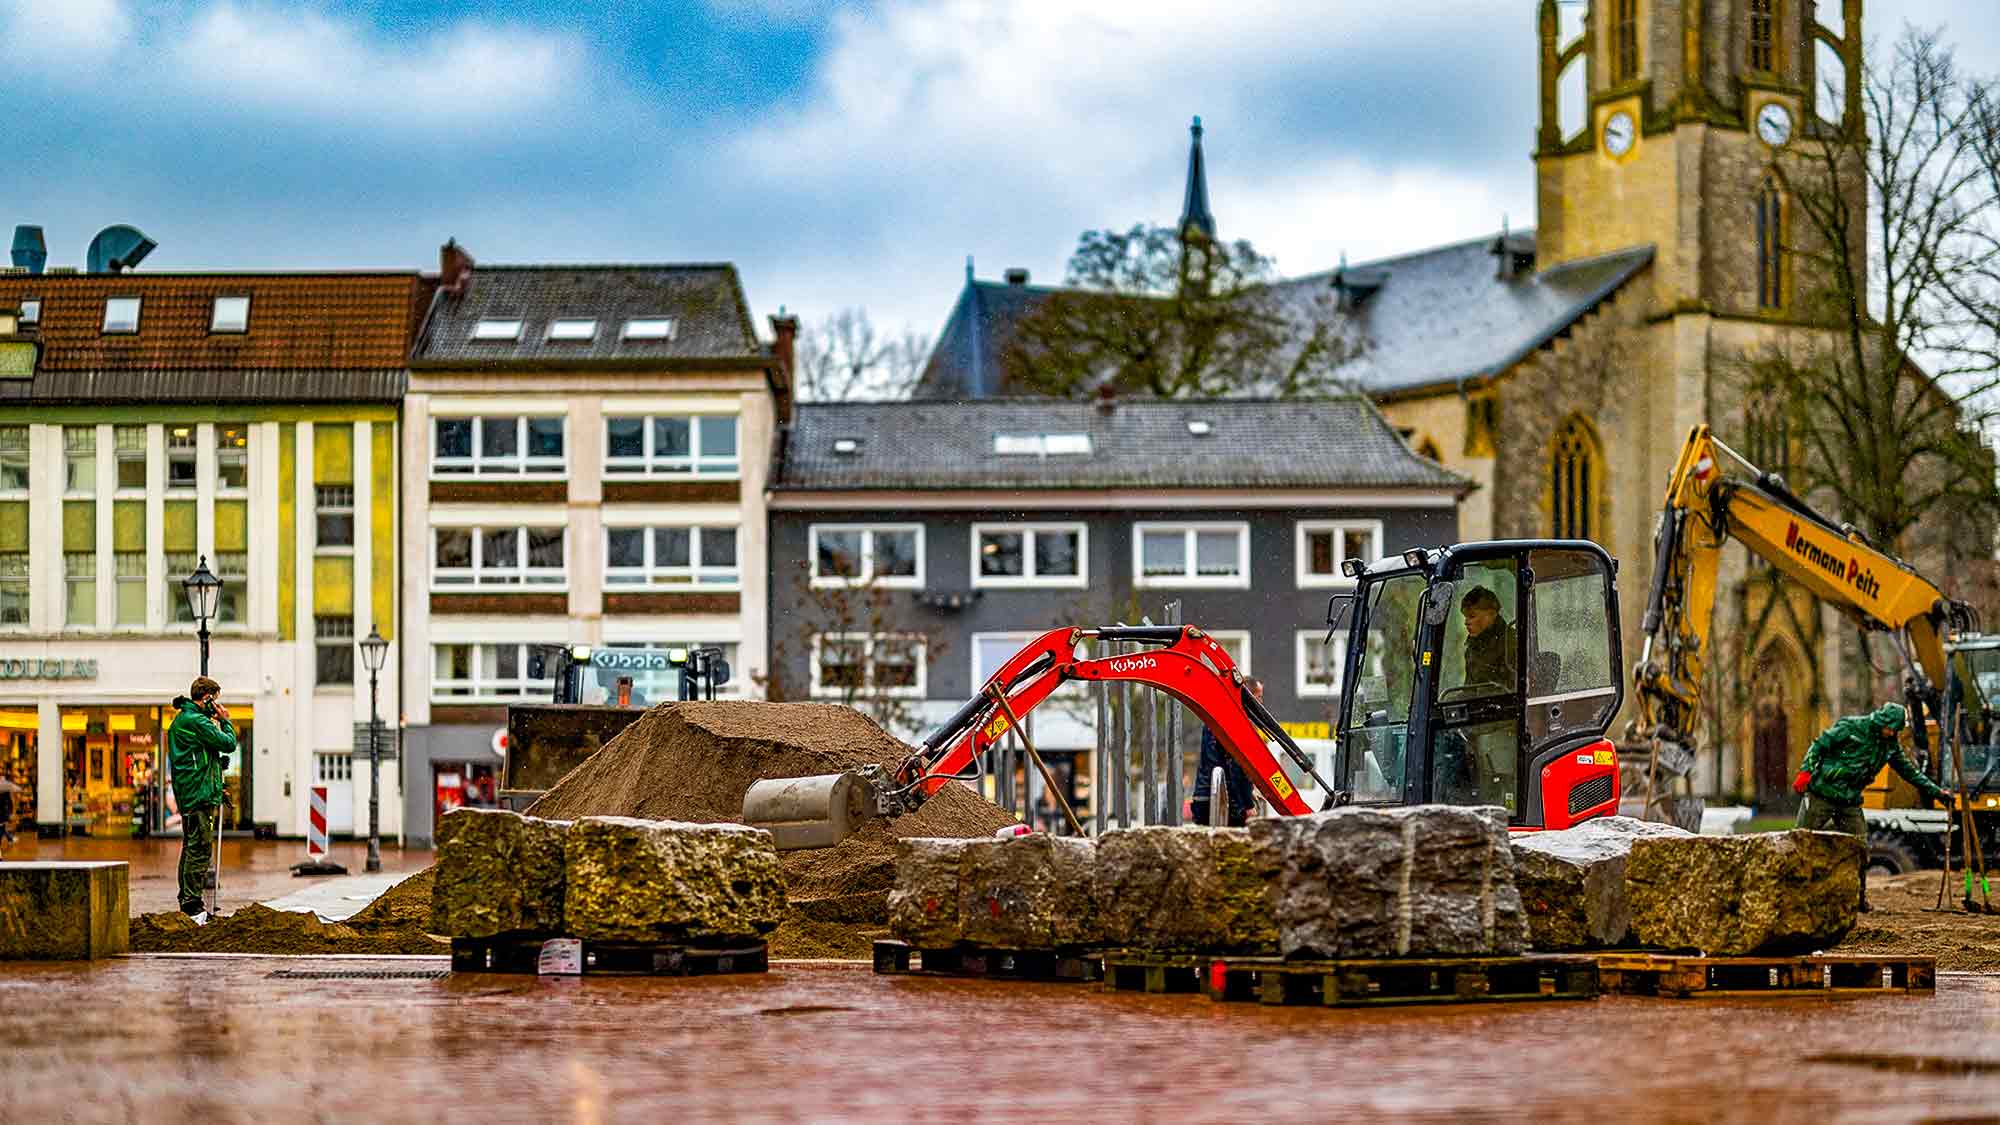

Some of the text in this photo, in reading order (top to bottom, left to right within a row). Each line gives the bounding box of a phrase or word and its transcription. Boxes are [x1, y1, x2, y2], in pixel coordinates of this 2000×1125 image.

[1785, 520, 1880, 600] Hermann Peitz
[592, 652, 667, 669] Kubota
[1110, 656, 1157, 672] Kubota
